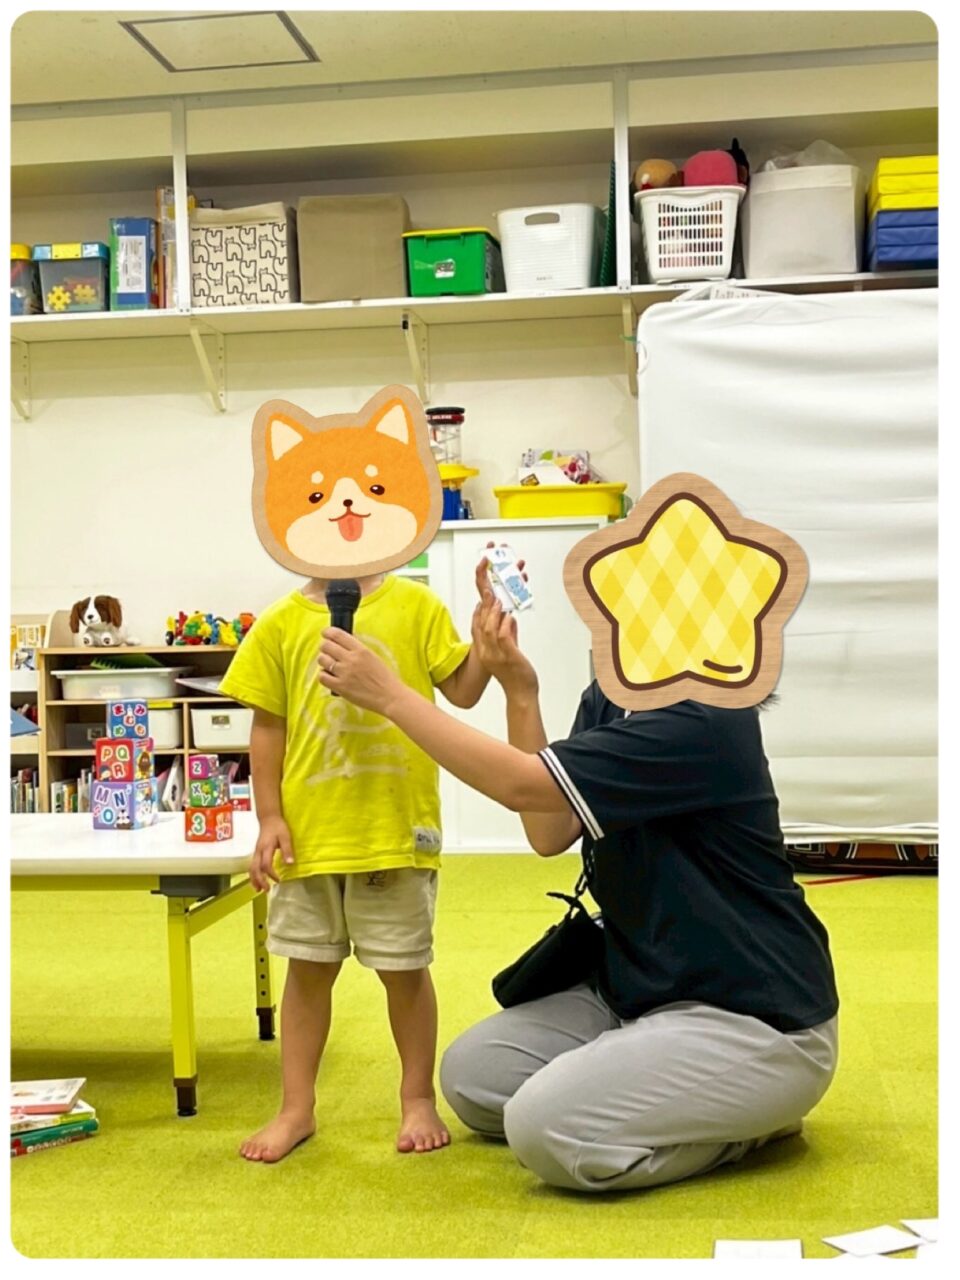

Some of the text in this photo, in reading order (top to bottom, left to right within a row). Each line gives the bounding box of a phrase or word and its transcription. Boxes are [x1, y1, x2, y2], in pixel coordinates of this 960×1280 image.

[101, 745, 129, 761] P Q
[112, 762, 126, 778] R
[95, 785, 126, 807] M N
[102, 808, 114, 823] O
[191, 812, 206, 835] 3
